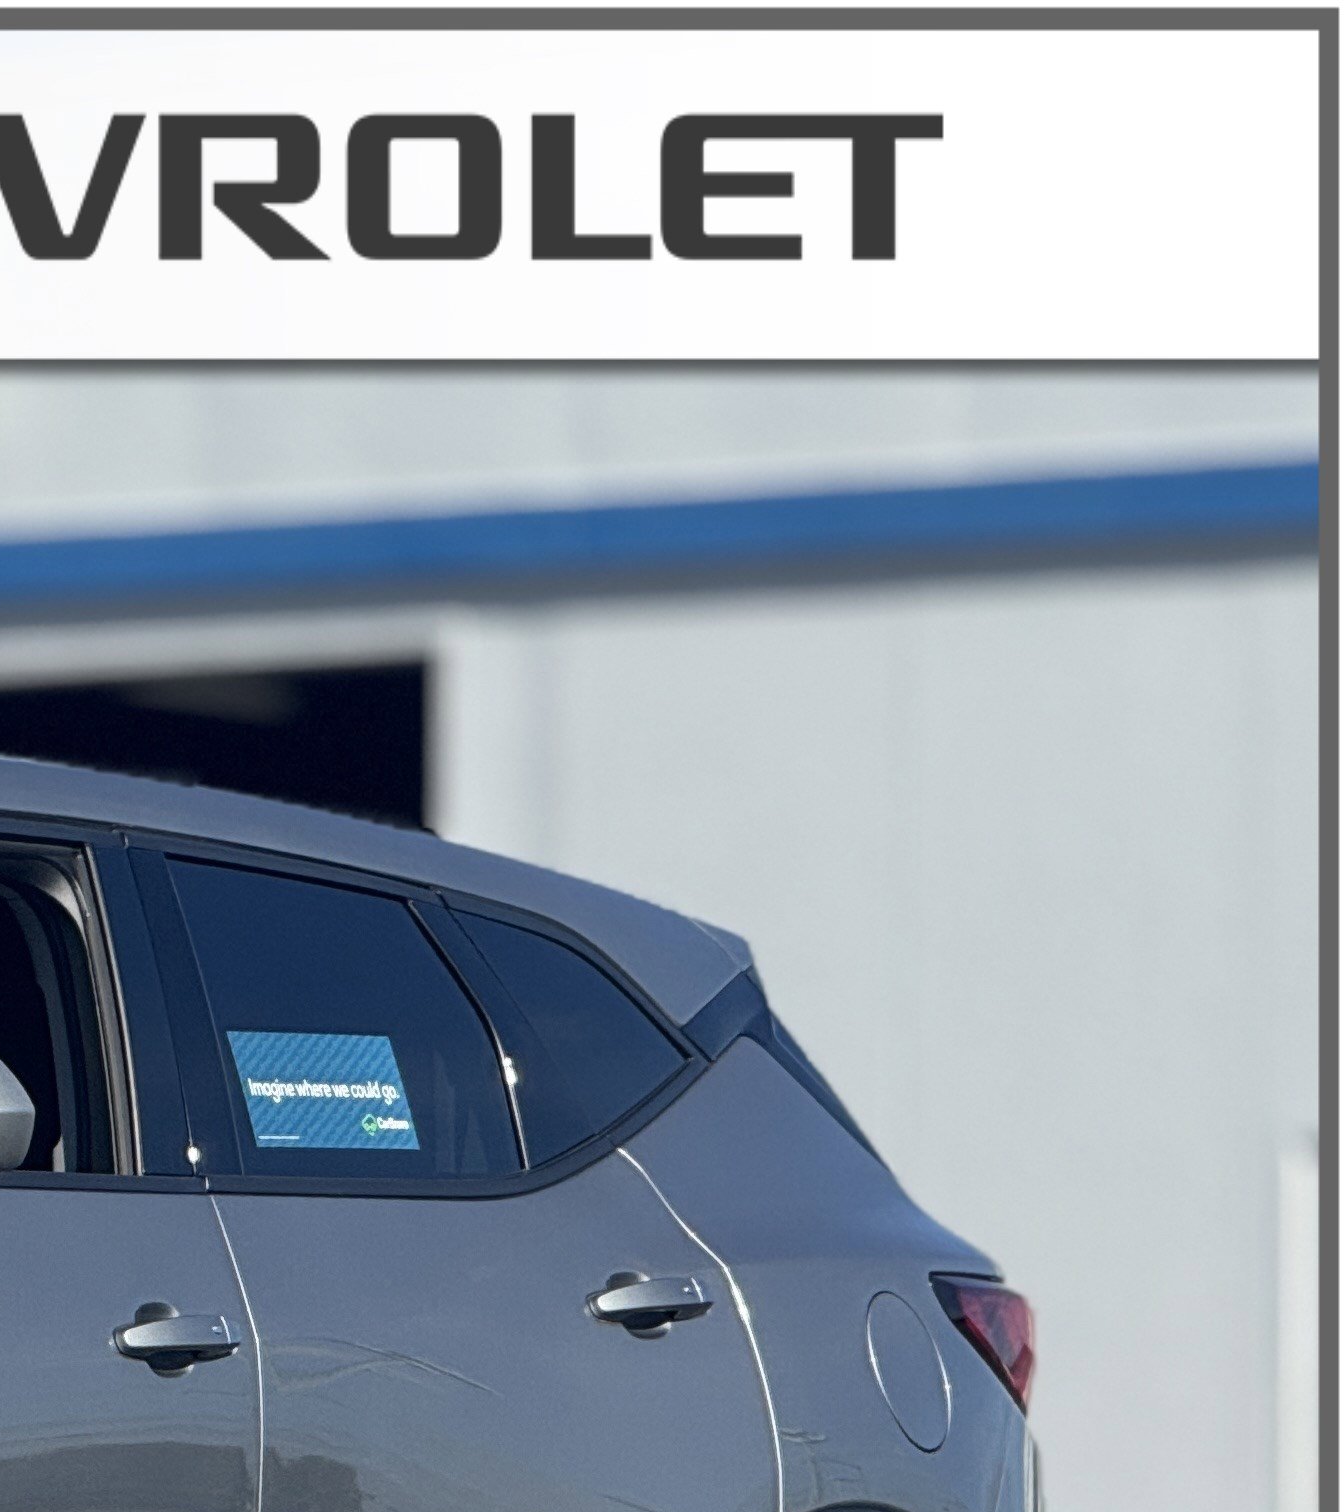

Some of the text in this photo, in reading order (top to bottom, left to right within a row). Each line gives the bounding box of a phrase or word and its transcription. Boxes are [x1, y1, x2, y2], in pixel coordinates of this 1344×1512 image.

[247, 1077, 400, 1105] Imagine where we could go.
